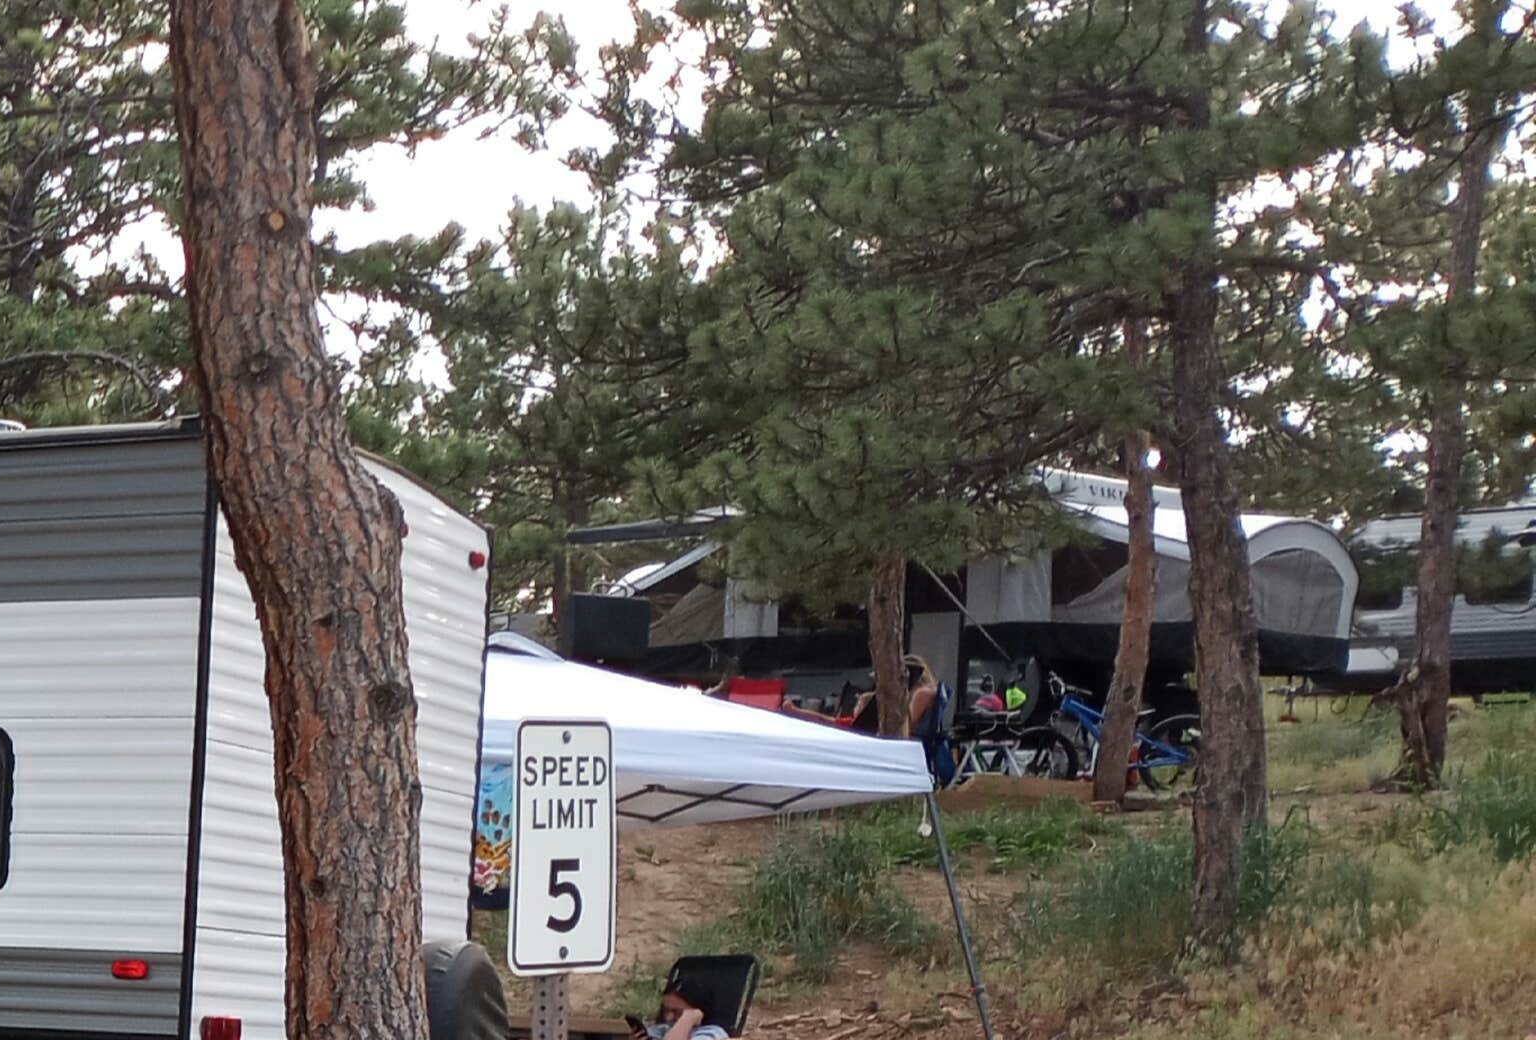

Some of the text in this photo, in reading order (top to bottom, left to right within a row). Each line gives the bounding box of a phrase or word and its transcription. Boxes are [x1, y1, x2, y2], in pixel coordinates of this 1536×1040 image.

[1089, 484, 1123, 501] VIKI
[523, 756, 607, 786] SPEED
[532, 798, 597, 829] LIMIT
[546, 858, 582, 933] 5
